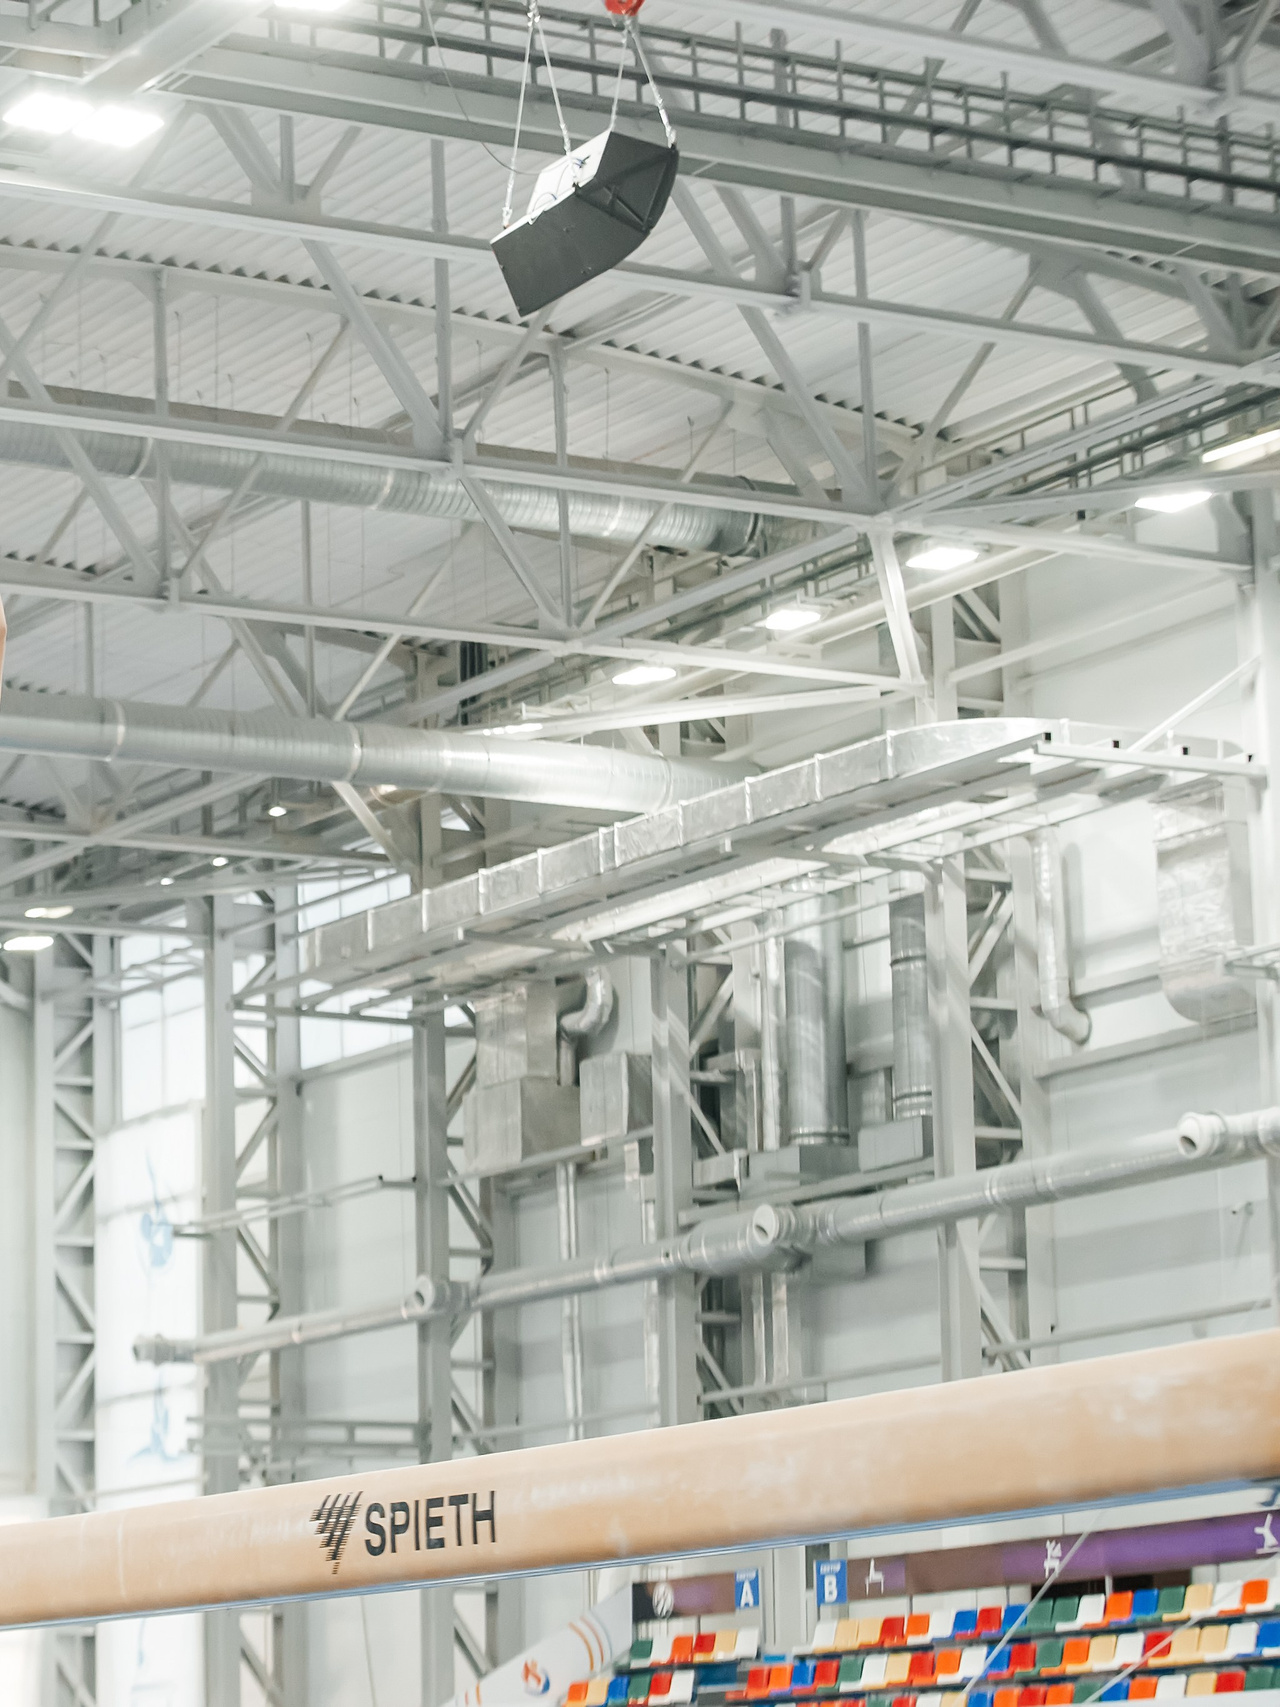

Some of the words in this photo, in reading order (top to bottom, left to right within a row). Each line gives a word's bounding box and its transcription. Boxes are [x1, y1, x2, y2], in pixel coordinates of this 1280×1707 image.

[364, 1490, 496, 1556] SPIETH
[740, 1579, 754, 1608] A
[824, 1574, 838, 1603] B
